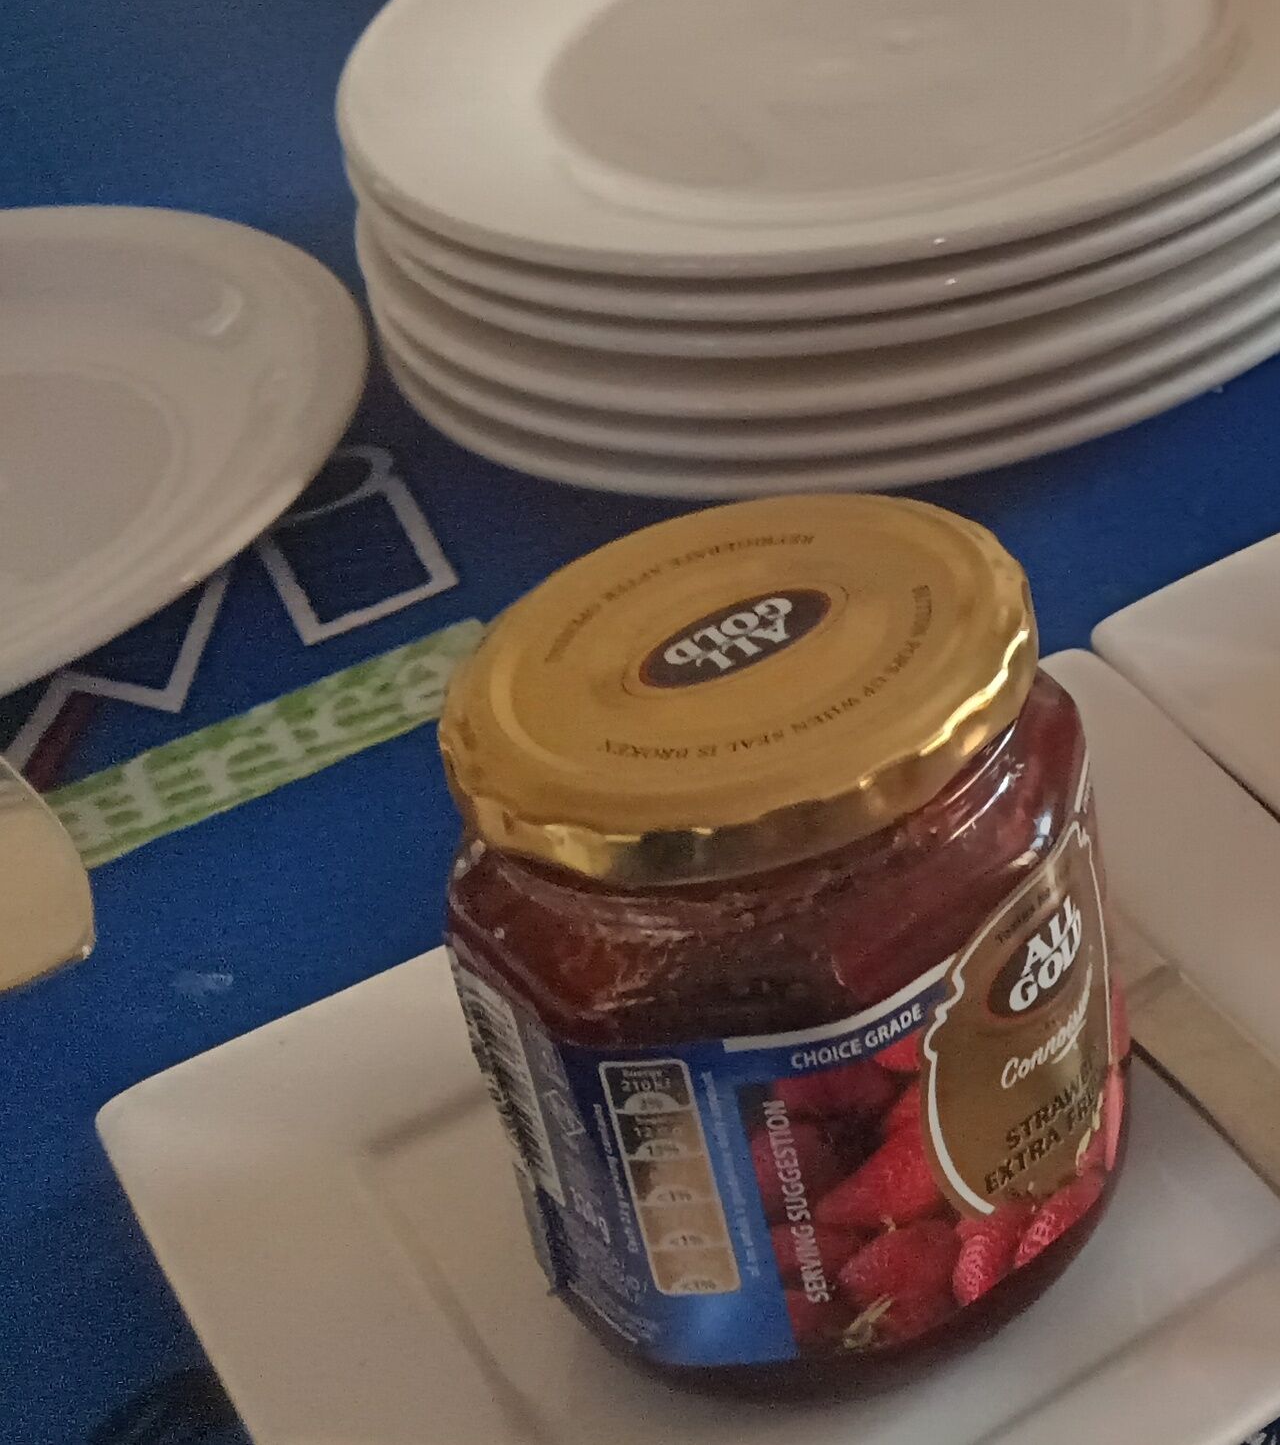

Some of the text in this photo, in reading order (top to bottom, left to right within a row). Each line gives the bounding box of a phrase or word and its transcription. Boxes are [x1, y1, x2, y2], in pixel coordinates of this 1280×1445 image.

[663, 597, 794, 666] GOLD
[695, 617, 791, 672] ALL
[1009, 907, 1082, 1012] GOLD
[1021, 894, 1077, 978] ALL
[790, 1003, 924, 1070] CHOICE GRADE
[984, 1128, 1064, 1195] EXTRA
[761, 1099, 831, 1305] SERVING SUGGESTION
